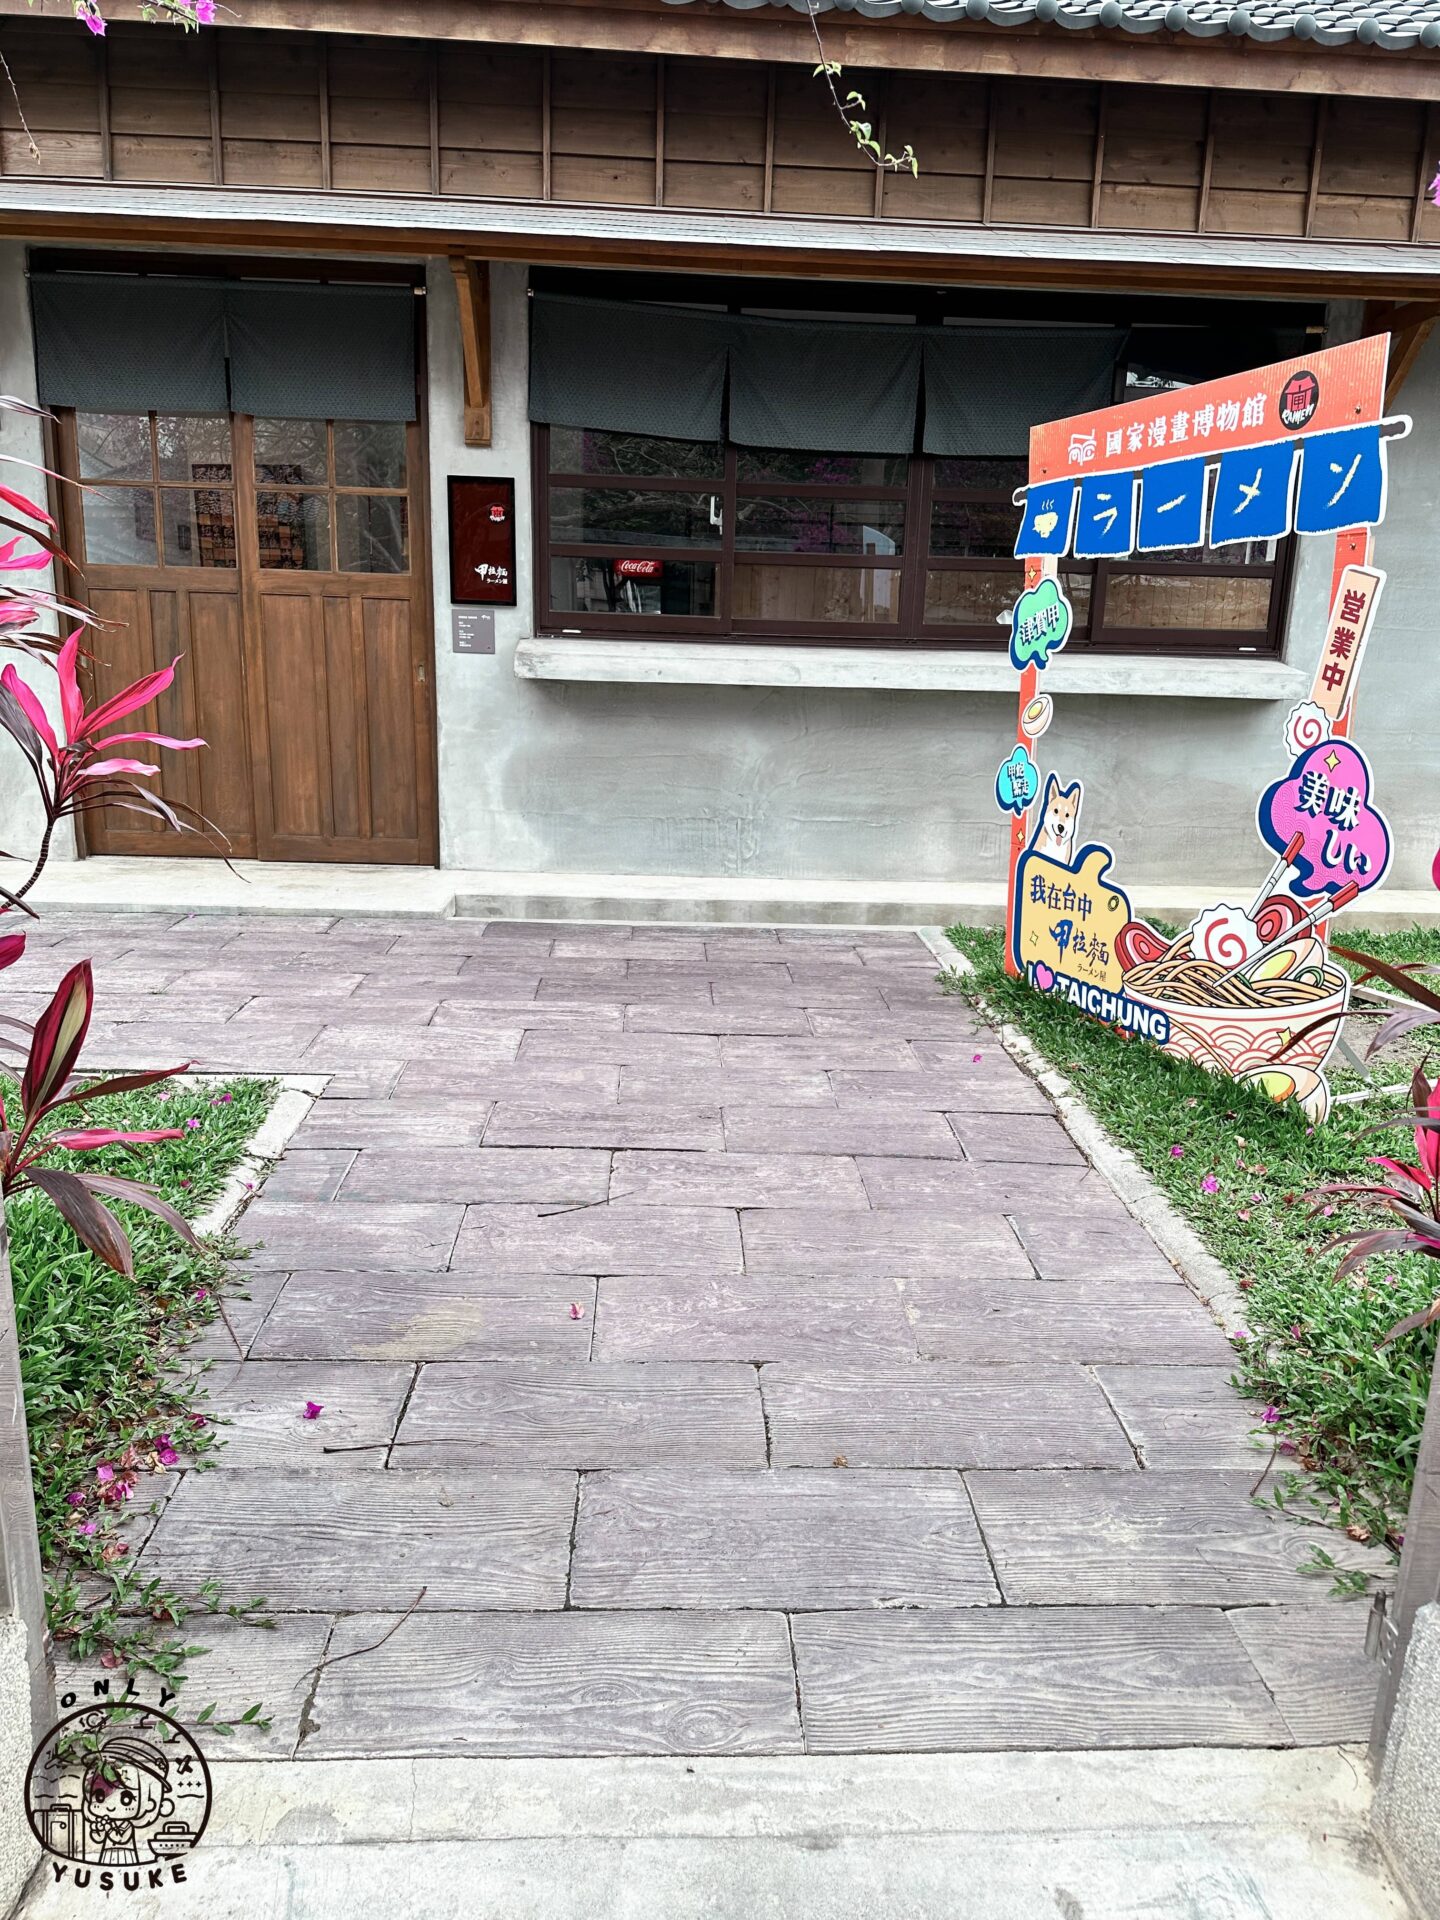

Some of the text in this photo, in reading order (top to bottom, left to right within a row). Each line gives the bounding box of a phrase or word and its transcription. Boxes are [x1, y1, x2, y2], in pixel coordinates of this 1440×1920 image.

[1105, 392, 1267, 458] 國家漫畫博物館
[1281, 403, 1315, 424] RAMEN
[1093, 454, 1361, 536] ラーメン
[1322, 589, 1366, 691] 営業中
[1297, 771, 1361, 830] 美味
[1322, 829, 1372, 875] しい
[1030, 874, 1092, 921] 我在台中
[1049, 919, 1109, 967] 甲拉麵
[1077, 963, 1107, 982] ラーメン屋
[1055, 973, 1167, 1041] TAICHUNG
